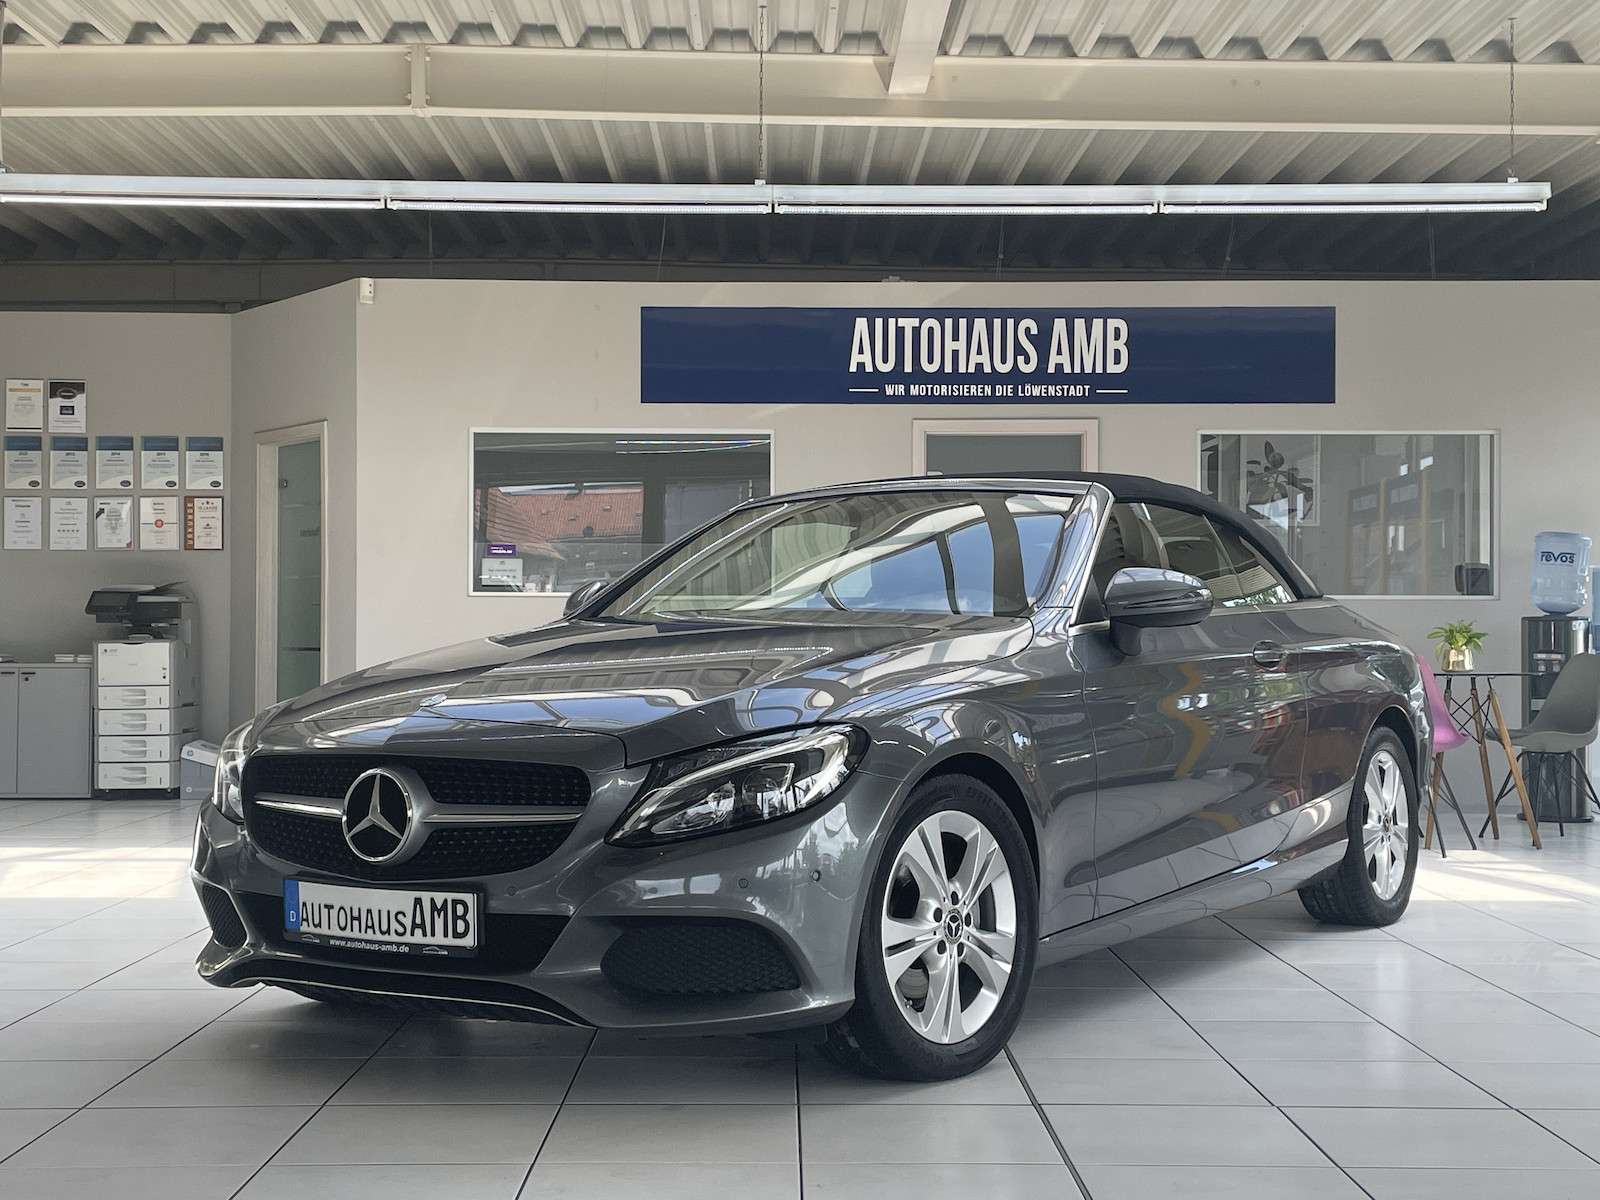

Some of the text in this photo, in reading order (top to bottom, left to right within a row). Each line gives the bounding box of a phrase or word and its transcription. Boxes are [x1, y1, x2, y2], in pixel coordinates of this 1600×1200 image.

[849, 317, 1128, 374] AUTOHAUS AMB
[885, 383, 1091, 397] WIR MOTORISIEREN DIE LÖWENSTADT
[1540, 551, 1576, 564] revos
[289, 910, 297, 922] D
[330, 938, 410, 953] www.autohaus-amb.de
